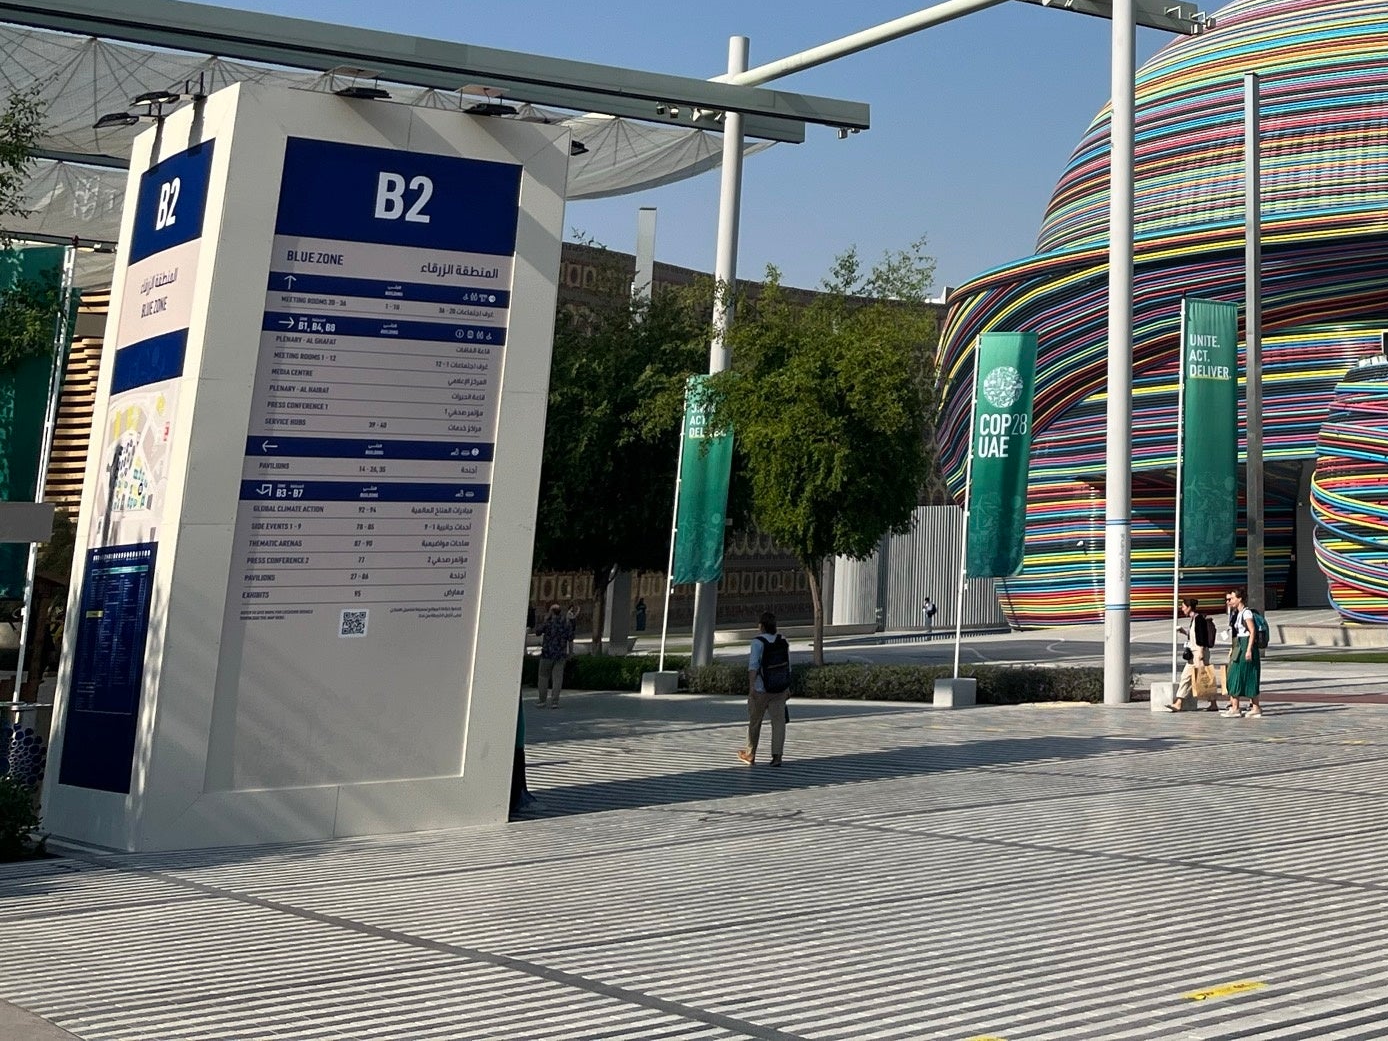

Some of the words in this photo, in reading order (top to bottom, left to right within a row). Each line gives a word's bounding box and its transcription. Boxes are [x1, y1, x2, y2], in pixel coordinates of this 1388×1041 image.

[155, 176, 181, 230] B2
[374, 171, 434, 223] B2
[286, 250, 315, 263] BLUE
[316, 252, 344, 266] ZONE
[420, 262, 454, 278] الزرقاء
[456, 265, 498, 278] المنطقة
[1190, 334, 1220, 347] UNITE.
[1189, 349, 1210, 362] ACT.
[1190, 364, 1232, 379] DELIVER.
[980, 414, 1028, 435] COP28
[978, 436, 1009, 458] UAE
[276, 489, 286, 497] B3
[293, 489, 303, 497] B7
